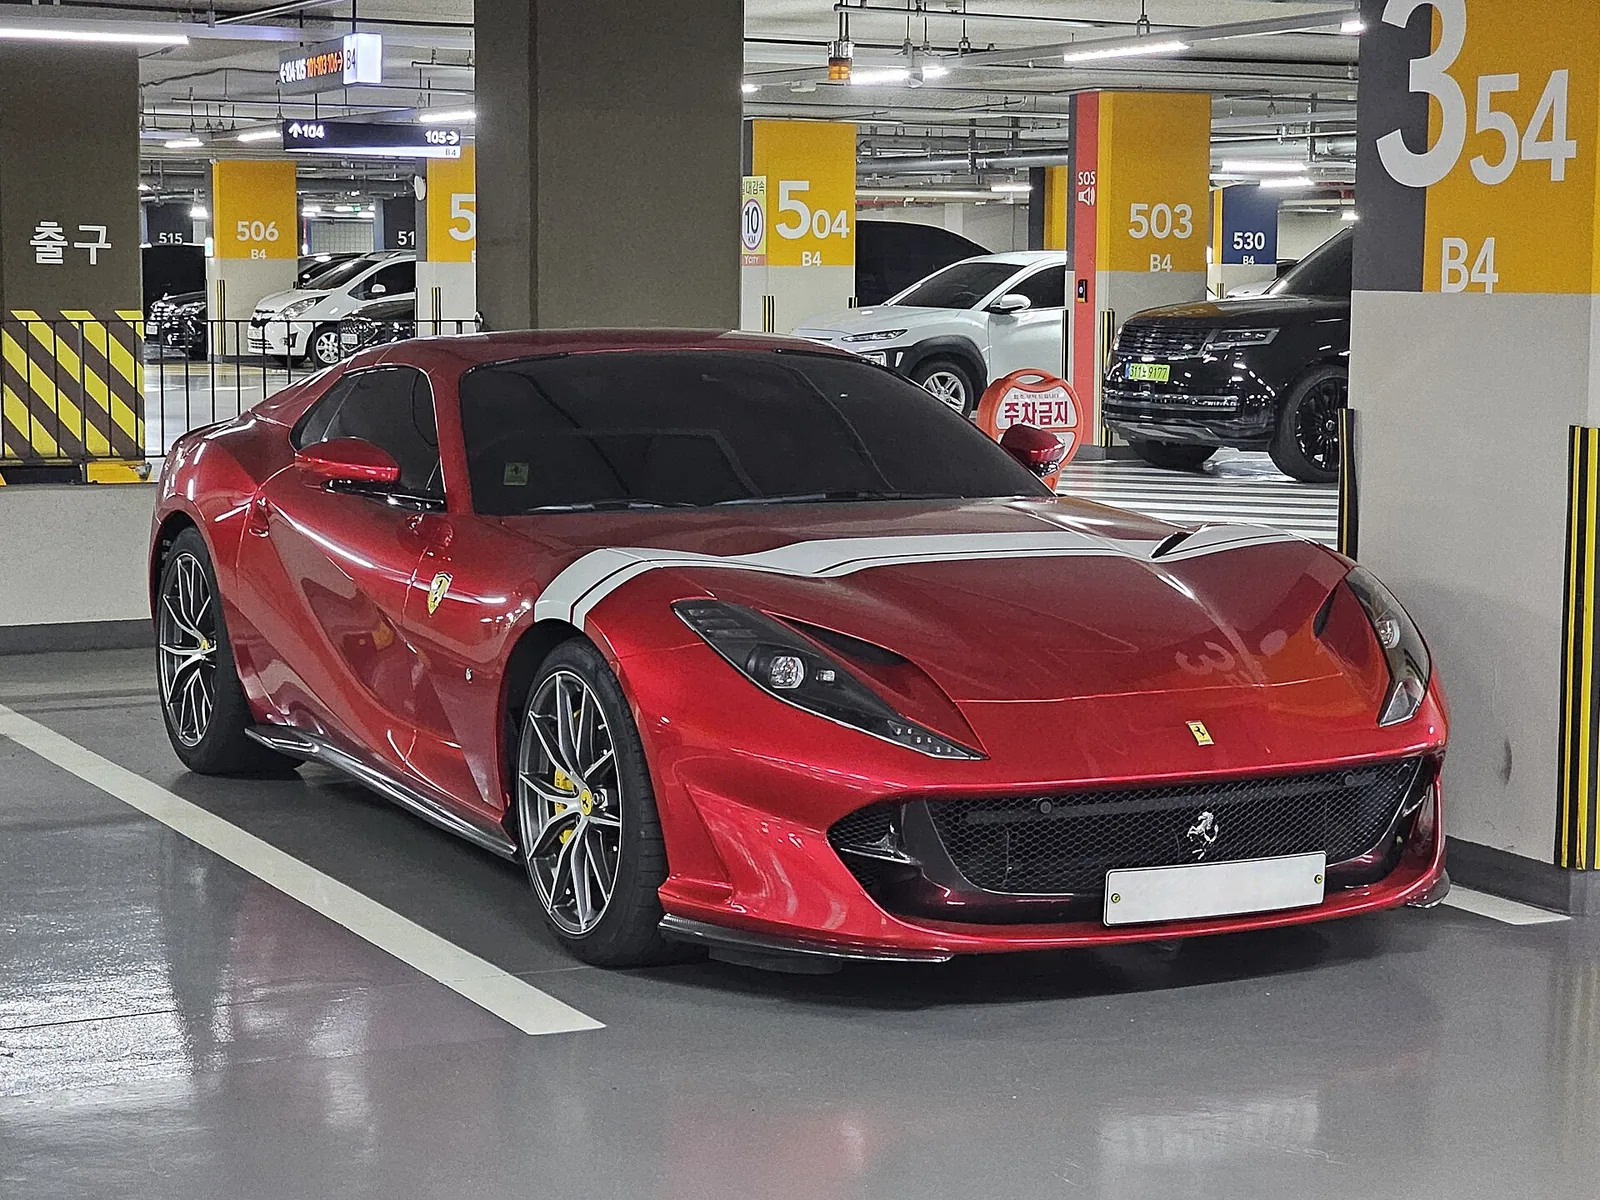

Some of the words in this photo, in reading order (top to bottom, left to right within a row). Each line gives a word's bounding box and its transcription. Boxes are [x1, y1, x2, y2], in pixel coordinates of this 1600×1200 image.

[346, 48, 356, 70] B4
[1376, 0, 1577, 188] 354
[302, 124, 325, 139] 104
[424, 130, 447, 144] 105
[1078, 171, 1096, 186] SOS
[448, 193, 476, 241] 5
[775, 180, 850, 239] 504
[236, 220, 279, 242] 506
[745, 206, 760, 235] 10
[1128, 203, 1193, 239] 503
[30, 221, 112, 265] 출구
[158, 232, 183, 244] 515
[397, 230, 415, 246] 51
[1232, 231, 1266, 250] 530
[250, 248, 267, 260] B4
[802, 251, 822, 267] B4
[1150, 253, 1173, 273] B4
[1242, 255, 1255, 265] B4
[1440, 237, 1499, 294] B4
[1004, 400, 1069, 426] 주차금지
